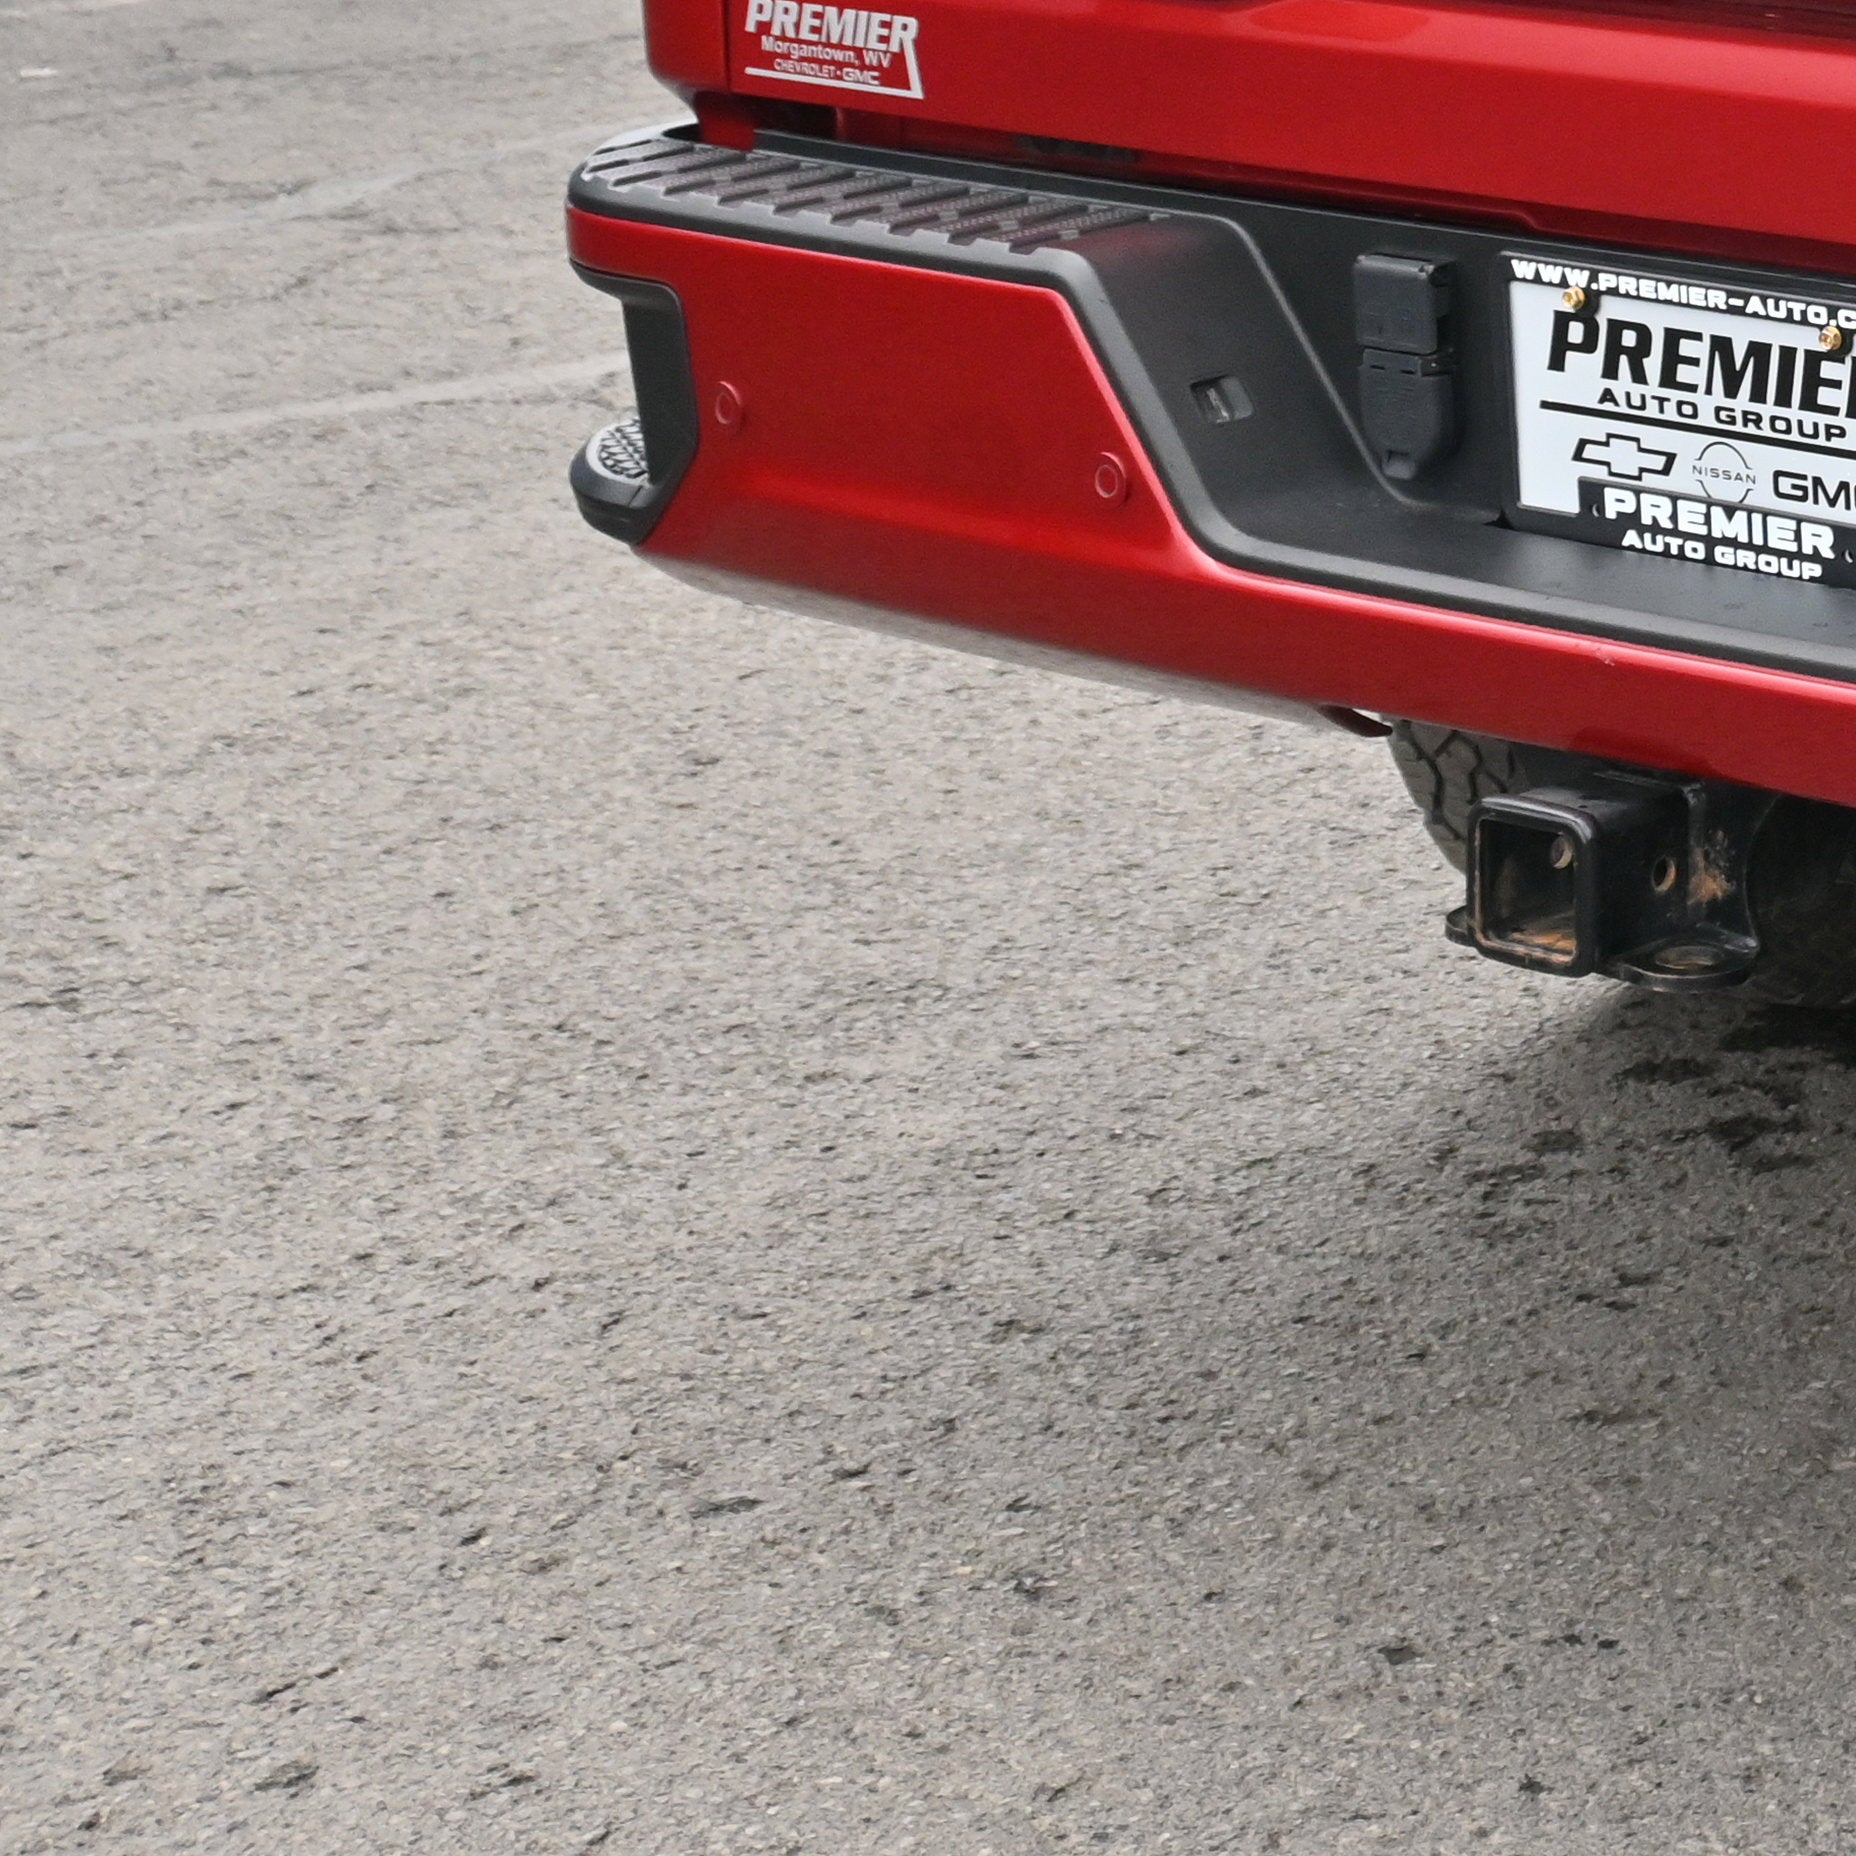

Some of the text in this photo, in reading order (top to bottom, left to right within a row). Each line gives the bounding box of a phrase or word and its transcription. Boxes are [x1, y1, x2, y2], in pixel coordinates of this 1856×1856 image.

[761, 35, 892, 68] Morgantown, WV
[774, 58, 881, 85] CHEVROLET GMC
[1598, 387, 1847, 444] AUTO GROUP
[1692, 464, 1757, 486] NISSAN
[1603, 487, 1835, 559] PREMIER
[1621, 528, 1823, 581] AUTO GROUP
